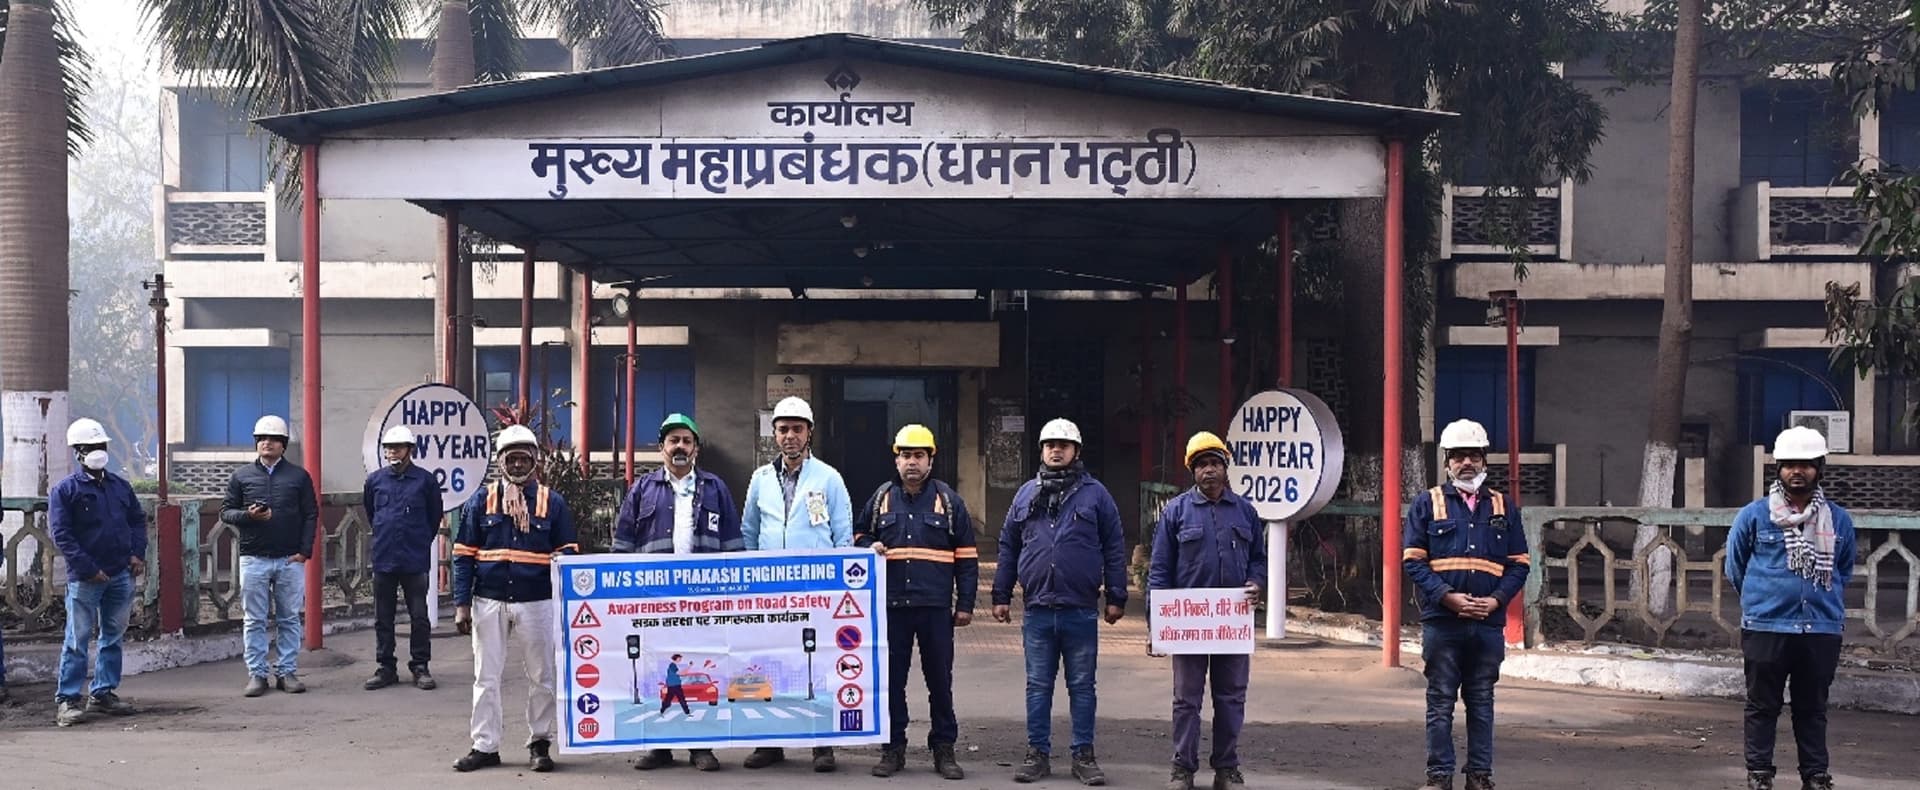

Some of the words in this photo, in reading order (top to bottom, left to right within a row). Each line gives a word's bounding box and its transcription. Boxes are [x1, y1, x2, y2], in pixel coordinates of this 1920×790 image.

[767, 92, 915, 126] कार्यालय
[528, 143, 652, 200] मुख्य
[402, 400, 470, 426] HAPPY
[1243, 406, 1301, 433] HAPPY
[433, 434, 487, 459] YEAR
[1227, 441, 1263, 467] NEW
[1266, 441, 1314, 469] YEAR
[433, 467, 465, 493] 26
[1240, 474, 1298, 503] 2026
[601, 570, 632, 588] M/S
[634, 568, 670, 586] SHRI
[672, 566, 740, 585] PRAKASH
[743, 563, 836, 583] ENGINEERING
[607, 601, 677, 615] Awareness
[679, 599, 734, 614] Program
[737, 599, 753, 610] on
[755, 596, 787, 609] Road
[790, 594, 831, 609] Safety
